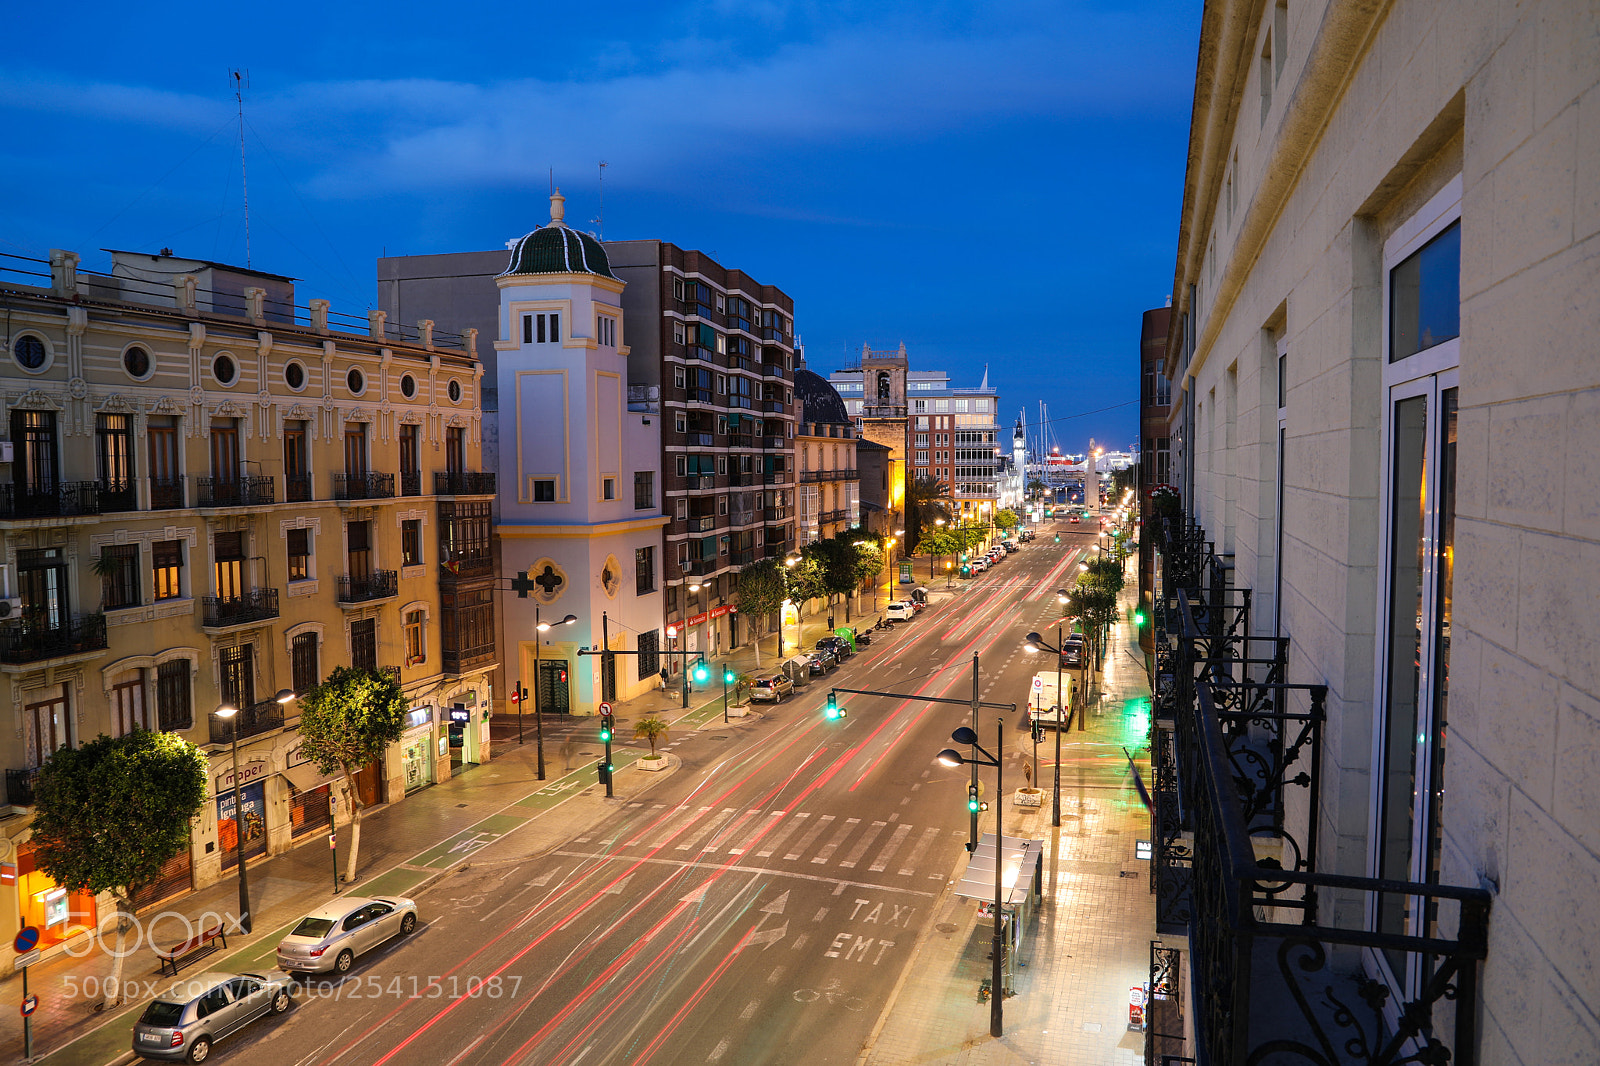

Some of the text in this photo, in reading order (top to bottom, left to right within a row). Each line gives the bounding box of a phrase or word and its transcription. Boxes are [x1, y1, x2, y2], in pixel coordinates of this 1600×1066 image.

[225, 764, 263, 785] maper
[849, 898, 917, 929] TAXI
[823, 932, 896, 966] EMT
